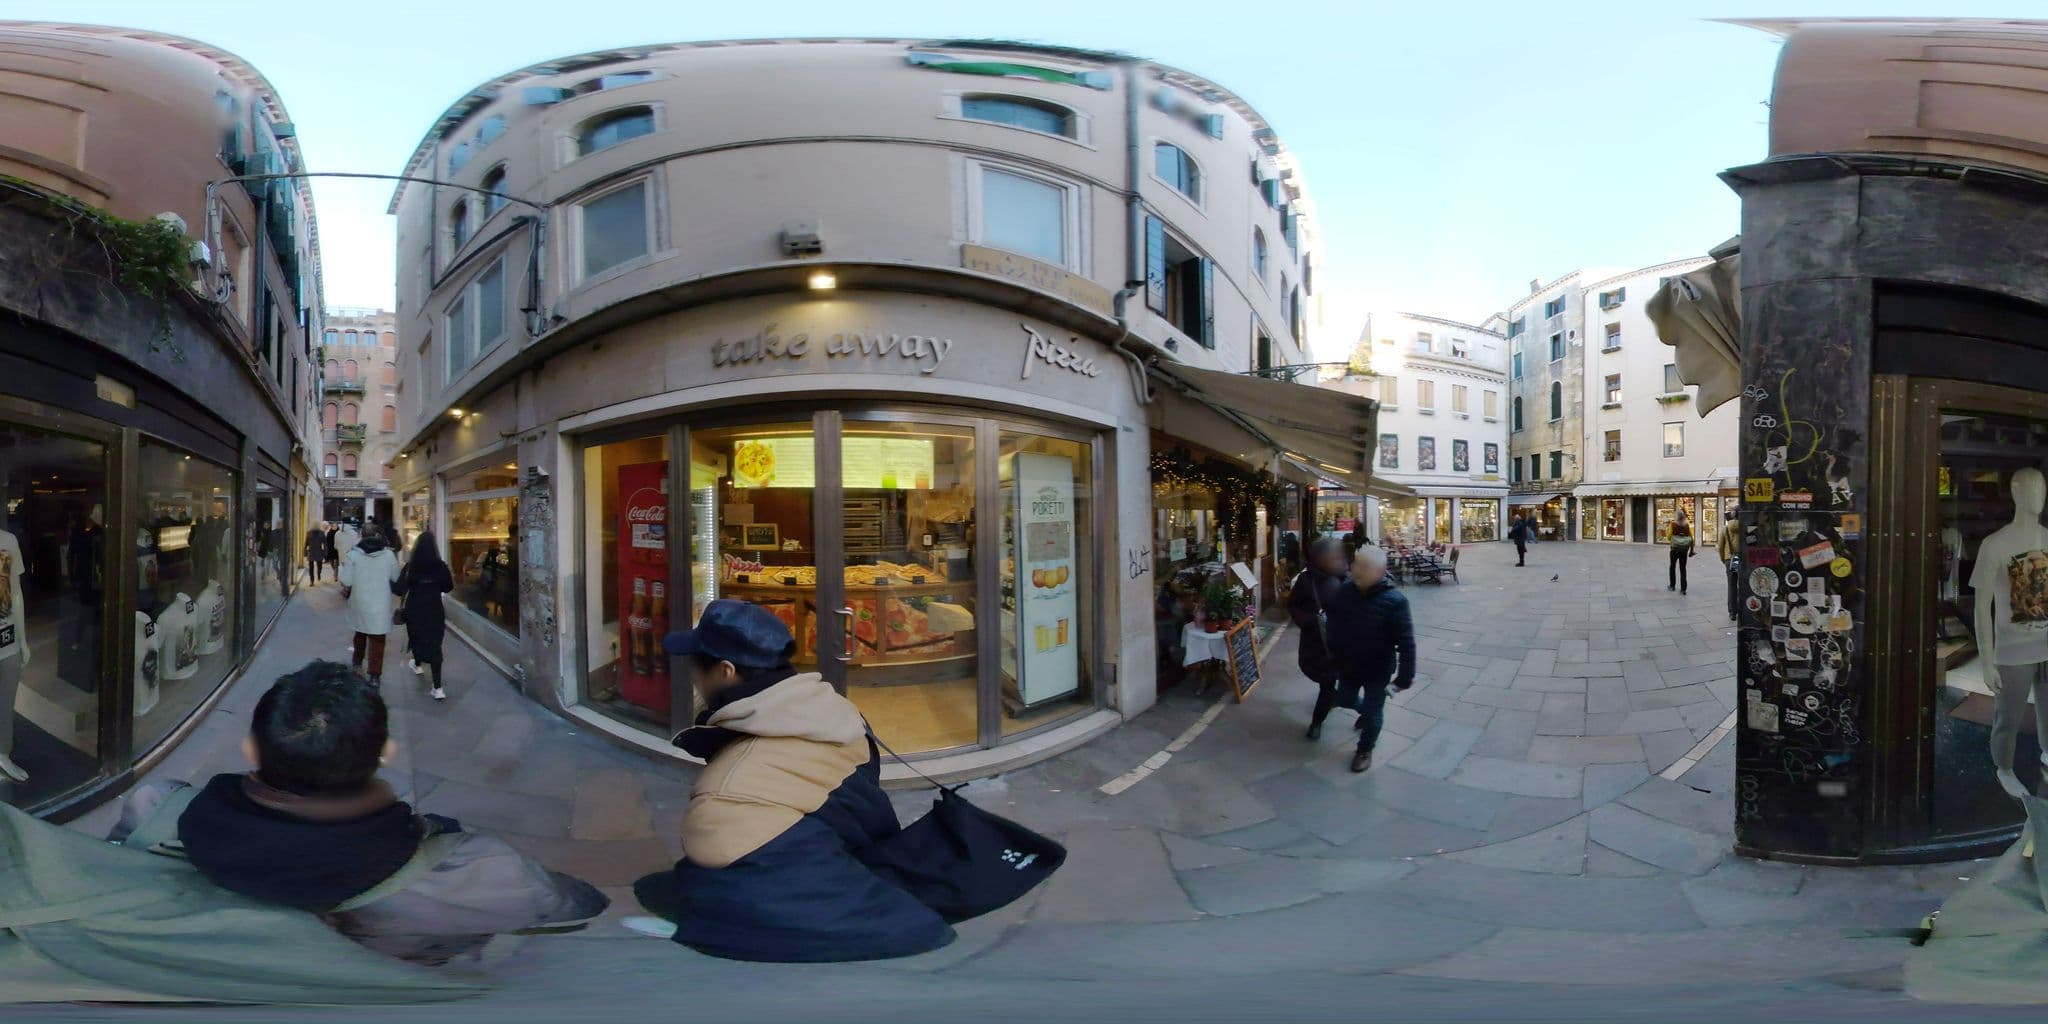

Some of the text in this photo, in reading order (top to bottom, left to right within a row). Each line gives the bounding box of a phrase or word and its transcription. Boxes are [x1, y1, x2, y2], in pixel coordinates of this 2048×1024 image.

[710, 321, 953, 374] take away
[1031, 501, 1065, 516] PORETTI
[0, 629, 11, 643] 15
